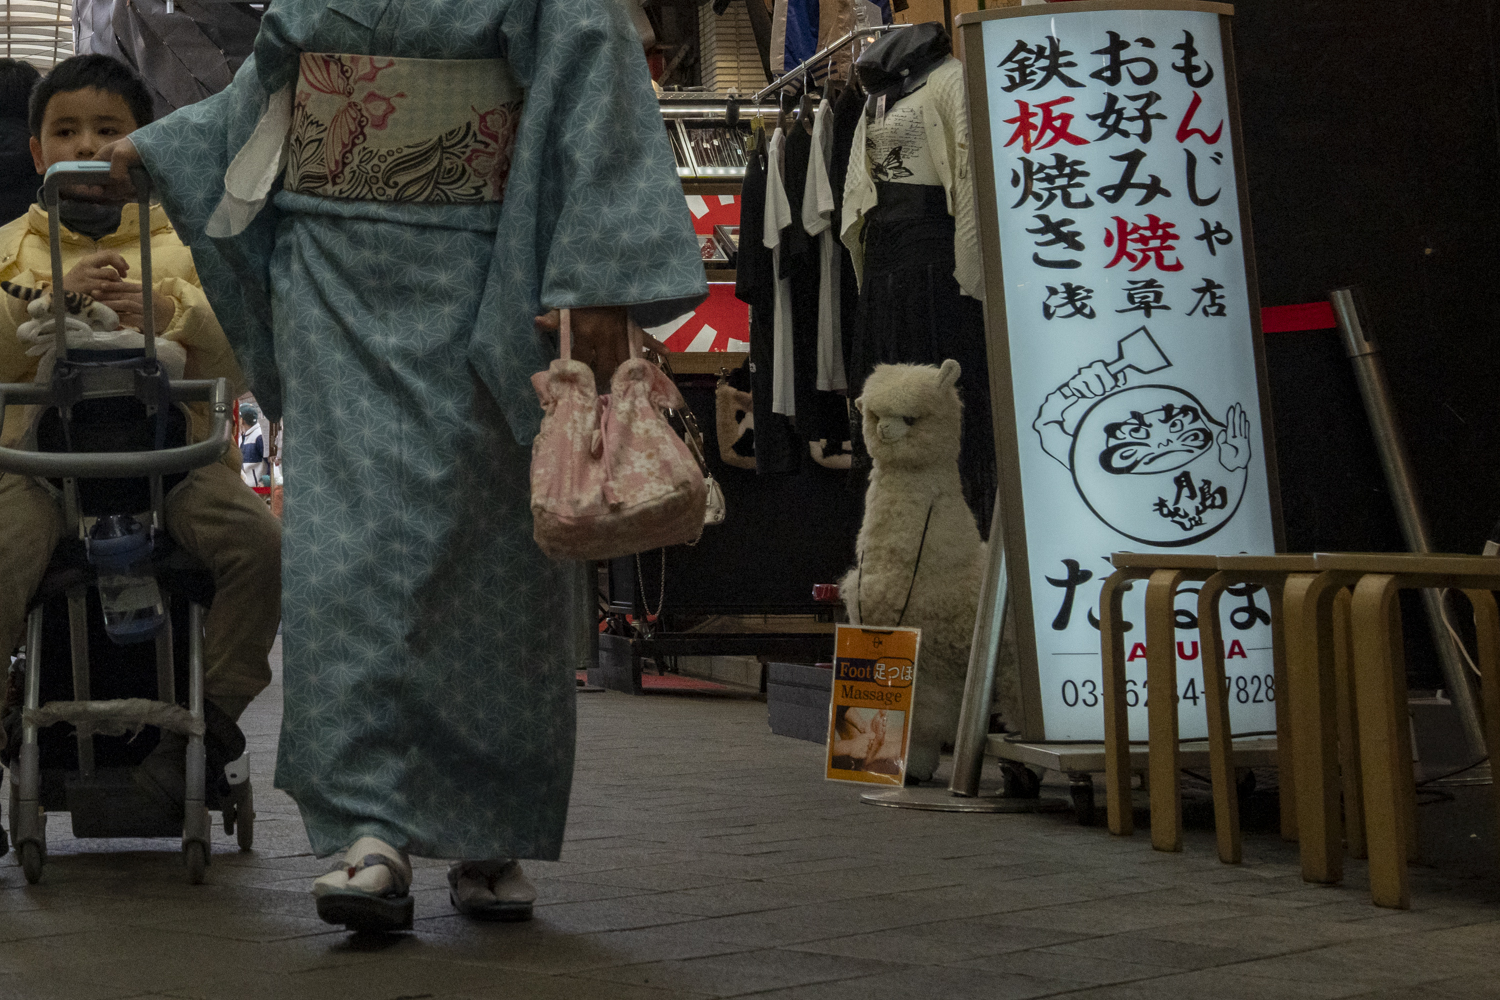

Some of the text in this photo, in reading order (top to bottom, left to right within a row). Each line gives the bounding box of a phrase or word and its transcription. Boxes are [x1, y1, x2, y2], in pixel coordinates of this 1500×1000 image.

[996, 35, 1096, 270] 鉄板焼き
[1085, 30, 1185, 273] お好み焼
[1171, 29, 1234, 257] もんじゃ
[1042, 278, 1228, 321] 浅草店
[1173, 470, 1228, 515] 月島
[839, 661, 914, 681] Foot 足つぼ
[841, 684, 902, 706] Massage
